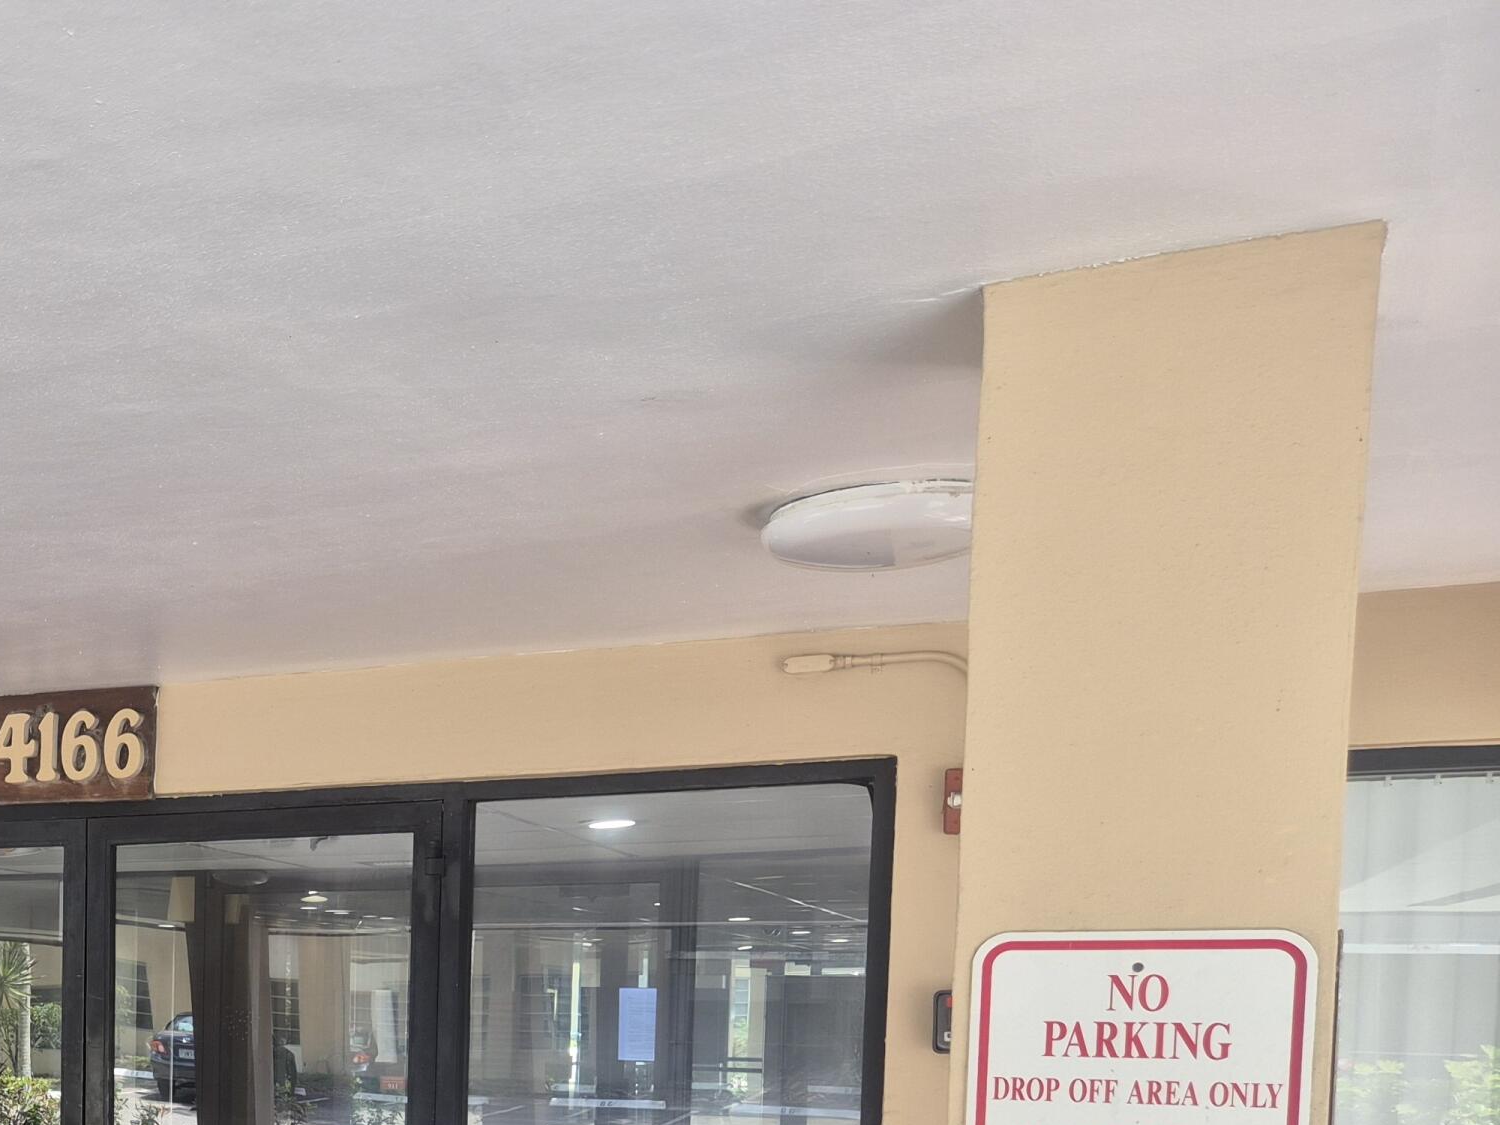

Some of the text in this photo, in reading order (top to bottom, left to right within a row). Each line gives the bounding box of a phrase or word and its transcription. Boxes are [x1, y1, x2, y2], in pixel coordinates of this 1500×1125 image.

[1106, 974, 1170, 1012] NO
[1042, 1020, 1233, 1060] PARKING
[993, 1076, 1283, 1110] DROP OFF AREA ONLY
